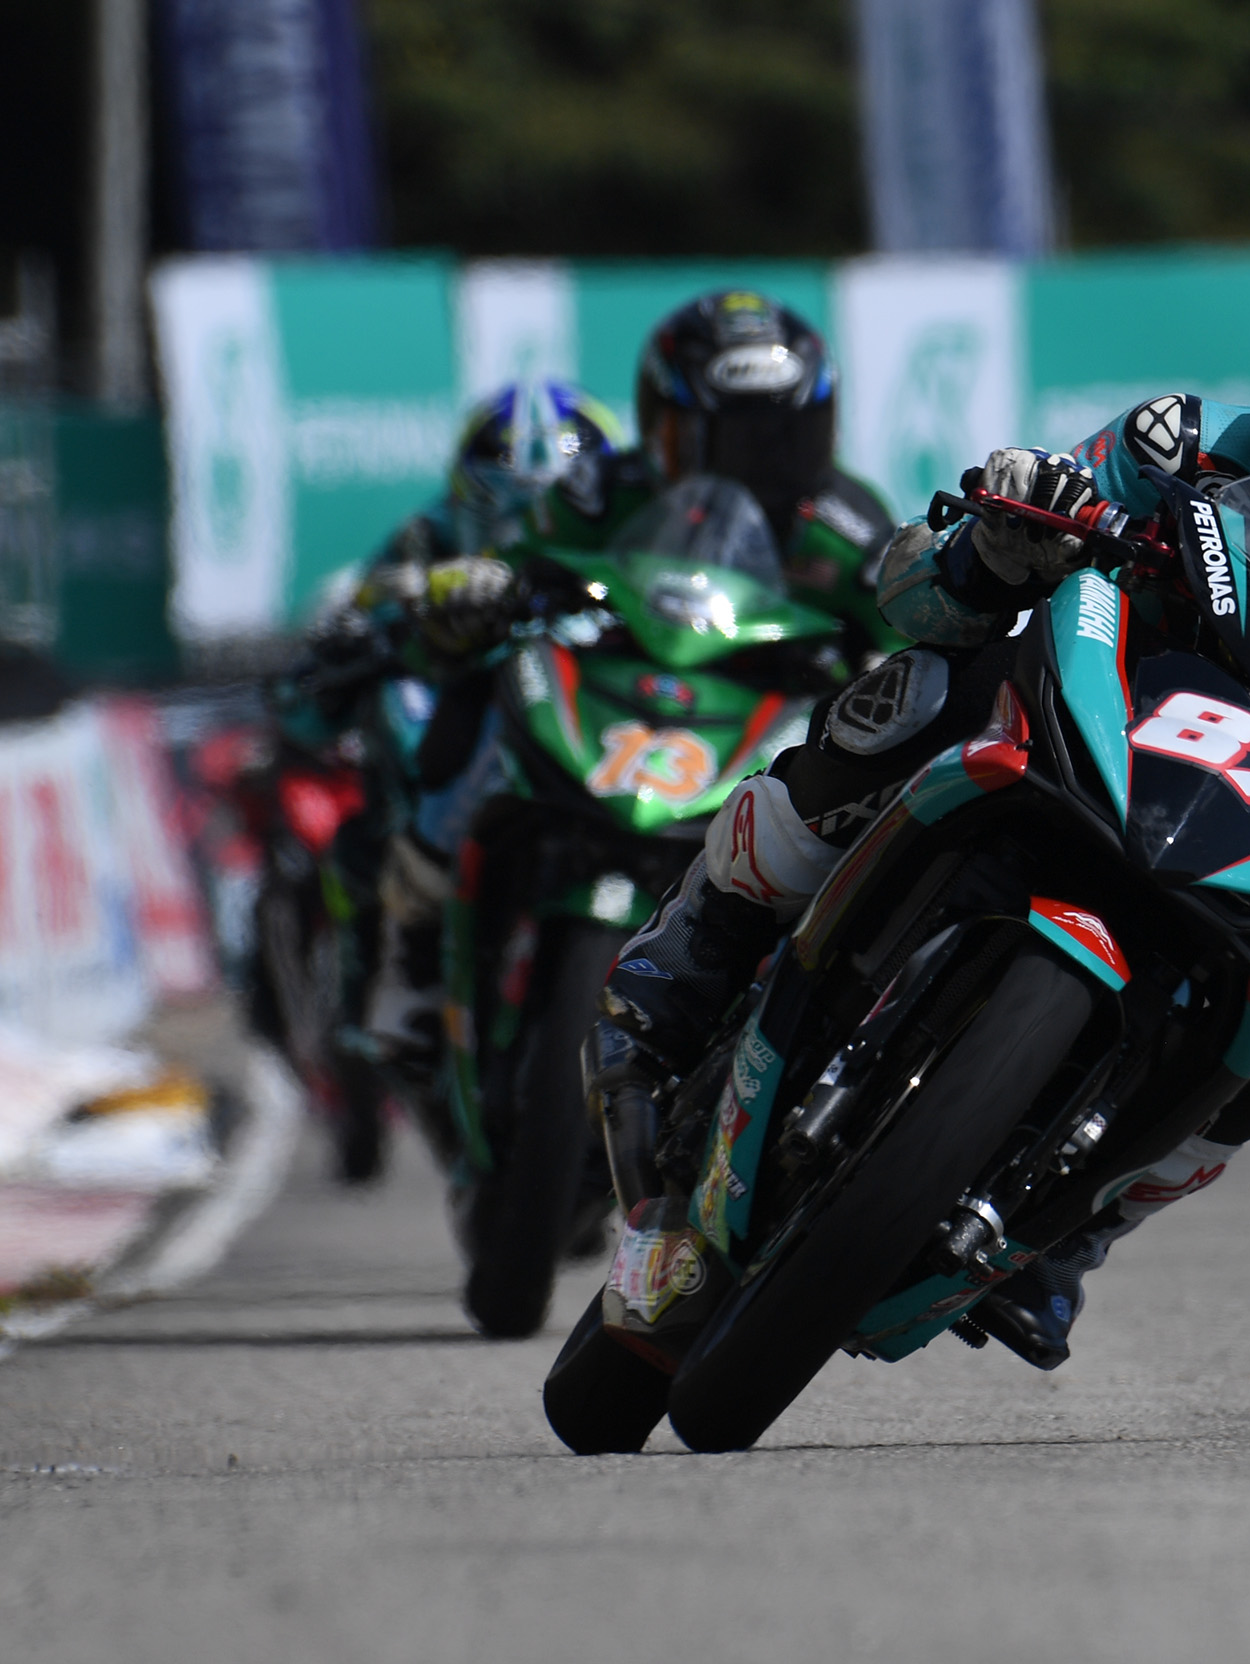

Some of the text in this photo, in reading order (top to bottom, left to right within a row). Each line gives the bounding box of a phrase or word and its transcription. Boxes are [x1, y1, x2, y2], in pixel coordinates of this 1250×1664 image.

[1190, 500, 1236, 616] PETRONAS
[1076, 573, 1116, 648] YAMAHA
[586, 718, 718, 806] 13
